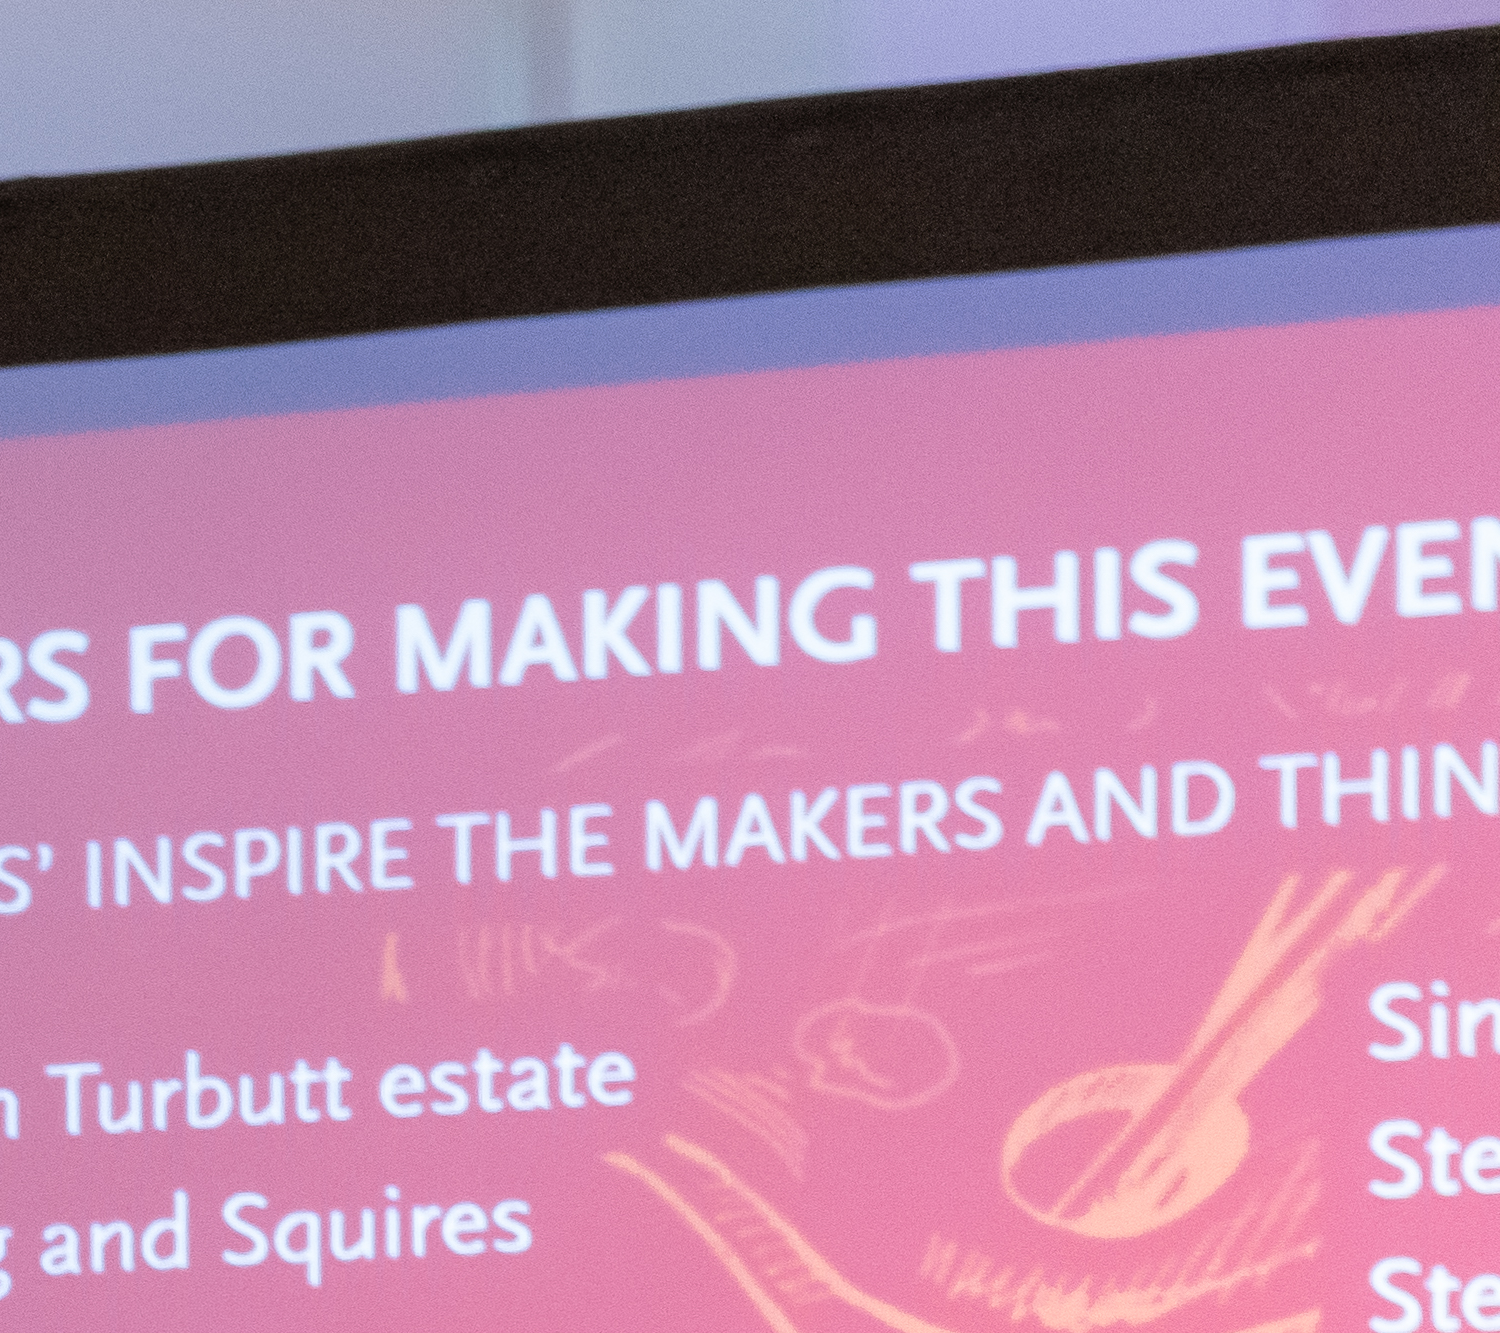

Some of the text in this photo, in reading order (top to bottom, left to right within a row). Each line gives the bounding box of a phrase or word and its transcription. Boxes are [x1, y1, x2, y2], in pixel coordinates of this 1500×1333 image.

[129, 610, 355, 714] FOR
[396, 564, 877, 695] MAKING
[909, 538, 1200, 654] THIS
[86, 817, 415, 910] INSPIRE
[436, 803, 614, 884] THE
[645, 776, 1004, 871] MAKERS
[1026, 760, 1236, 847] AND
[45, 1049, 352, 1136] Turbutt
[380, 1042, 636, 1119] estate
[40, 1189, 190, 1276] and
[221, 1185, 534, 1287] Squires
